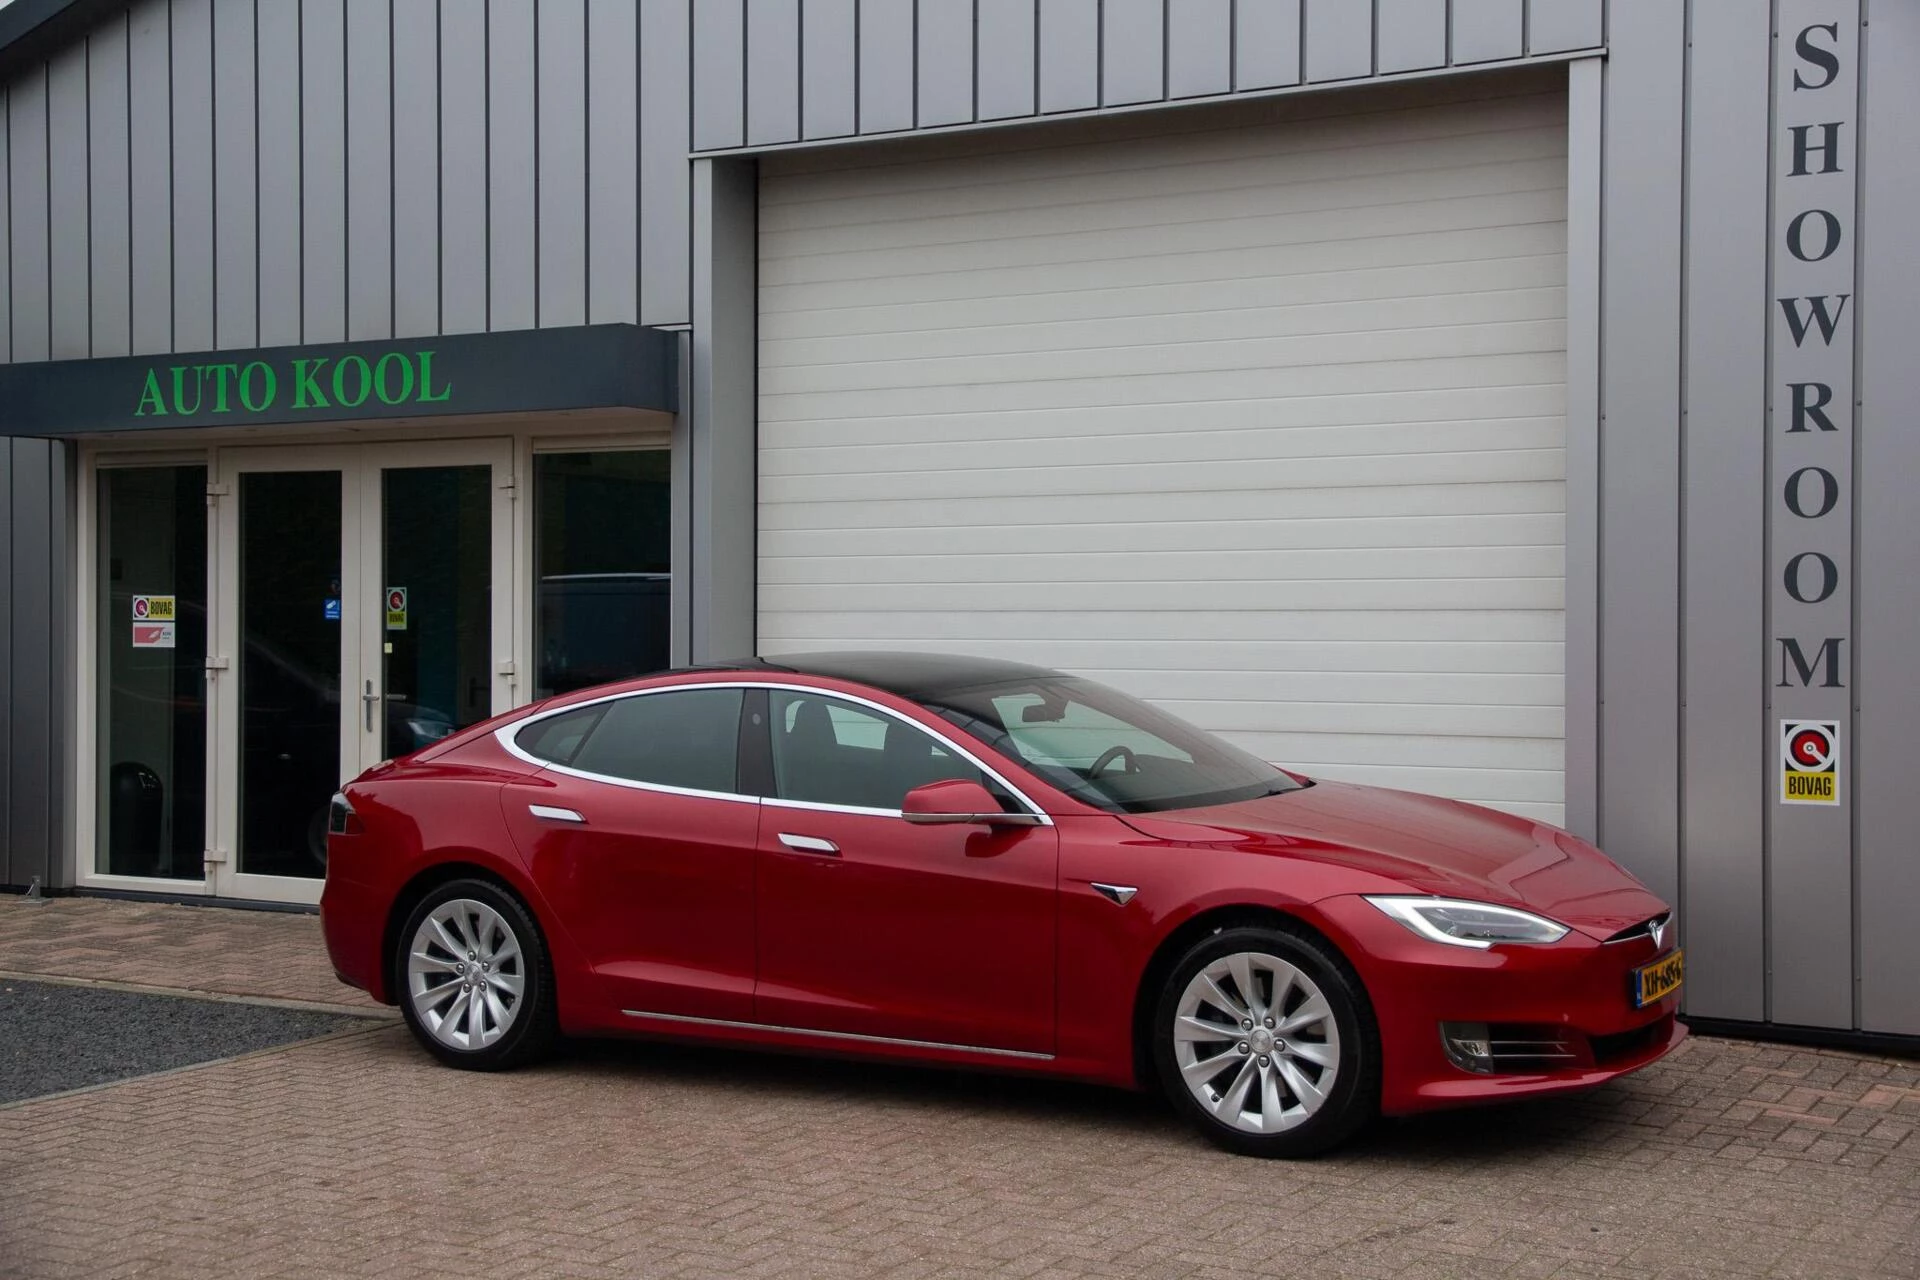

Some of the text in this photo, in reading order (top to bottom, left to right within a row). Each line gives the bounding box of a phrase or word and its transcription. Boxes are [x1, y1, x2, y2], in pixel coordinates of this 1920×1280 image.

[1775, 21, 1851, 688] SHOWROOM
[134, 351, 451, 416] AUTO KOOL
[150, 601, 173, 615] BOVAG
[1788, 776, 1831, 796] BOVAG
